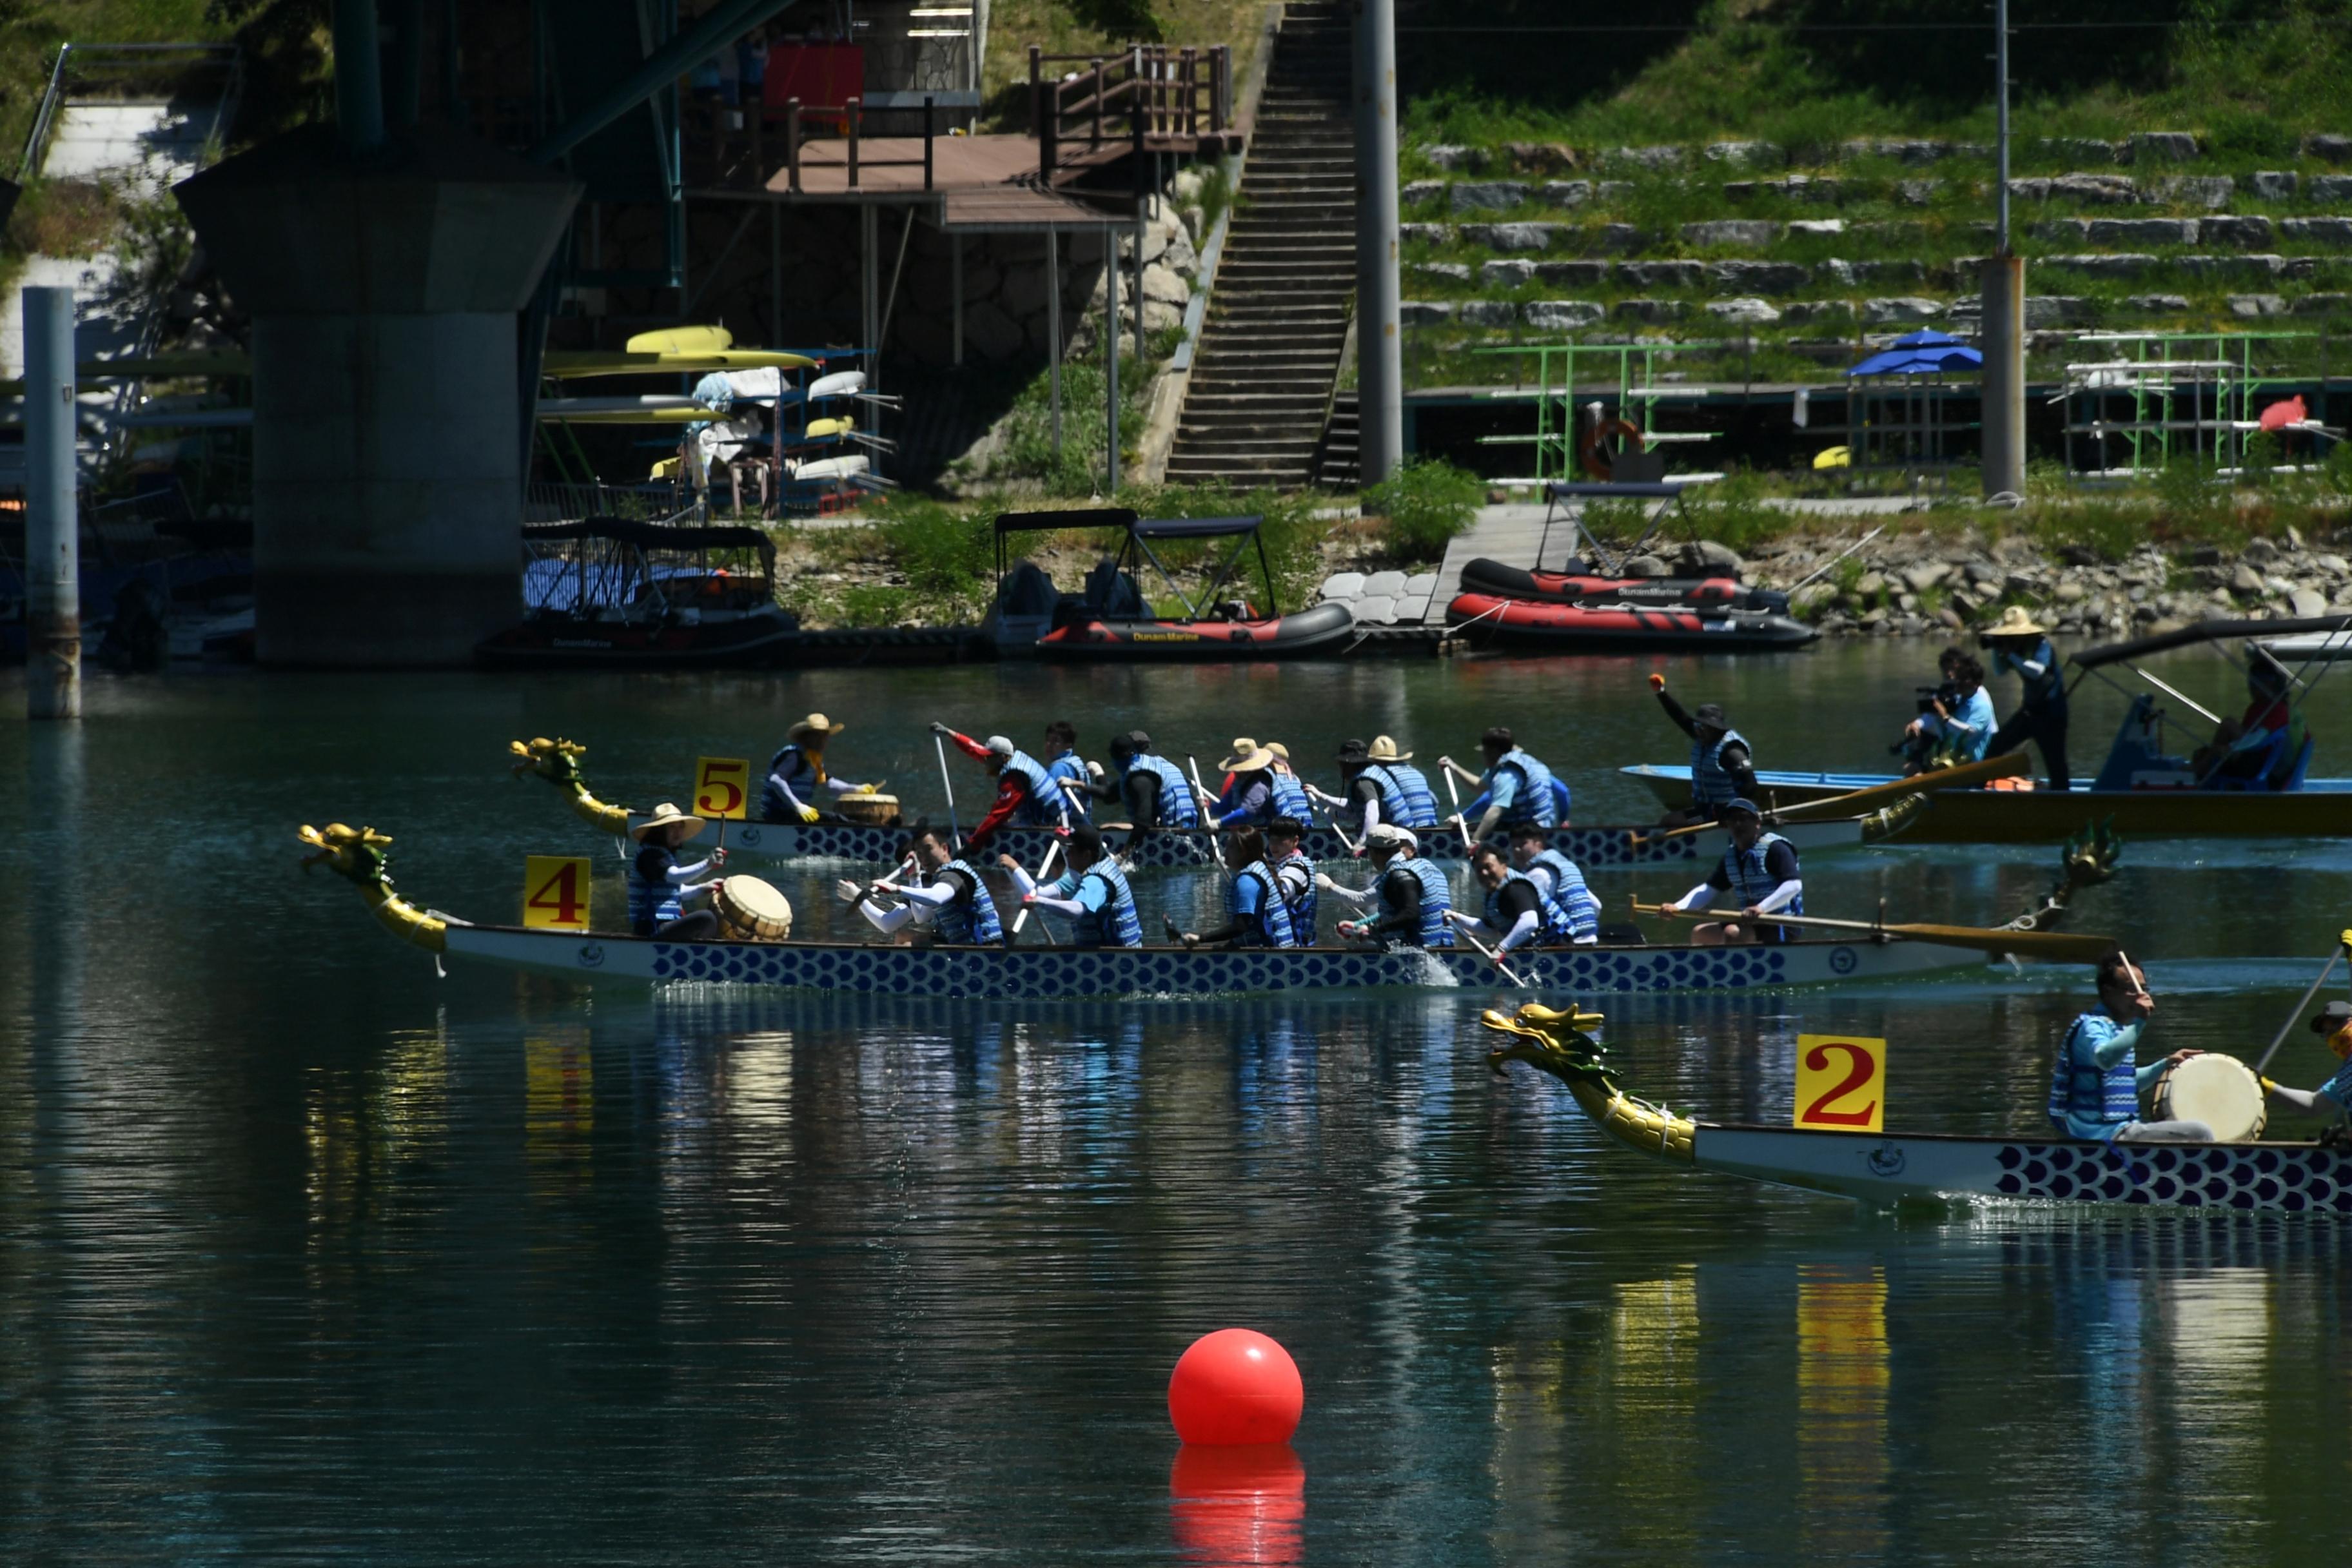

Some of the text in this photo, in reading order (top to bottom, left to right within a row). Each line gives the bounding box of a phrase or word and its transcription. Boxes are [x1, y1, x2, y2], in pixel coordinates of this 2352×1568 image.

[699, 763, 742, 812] 5
[529, 862, 585, 923] 4
[1801, 1043, 1876, 1126] 2
